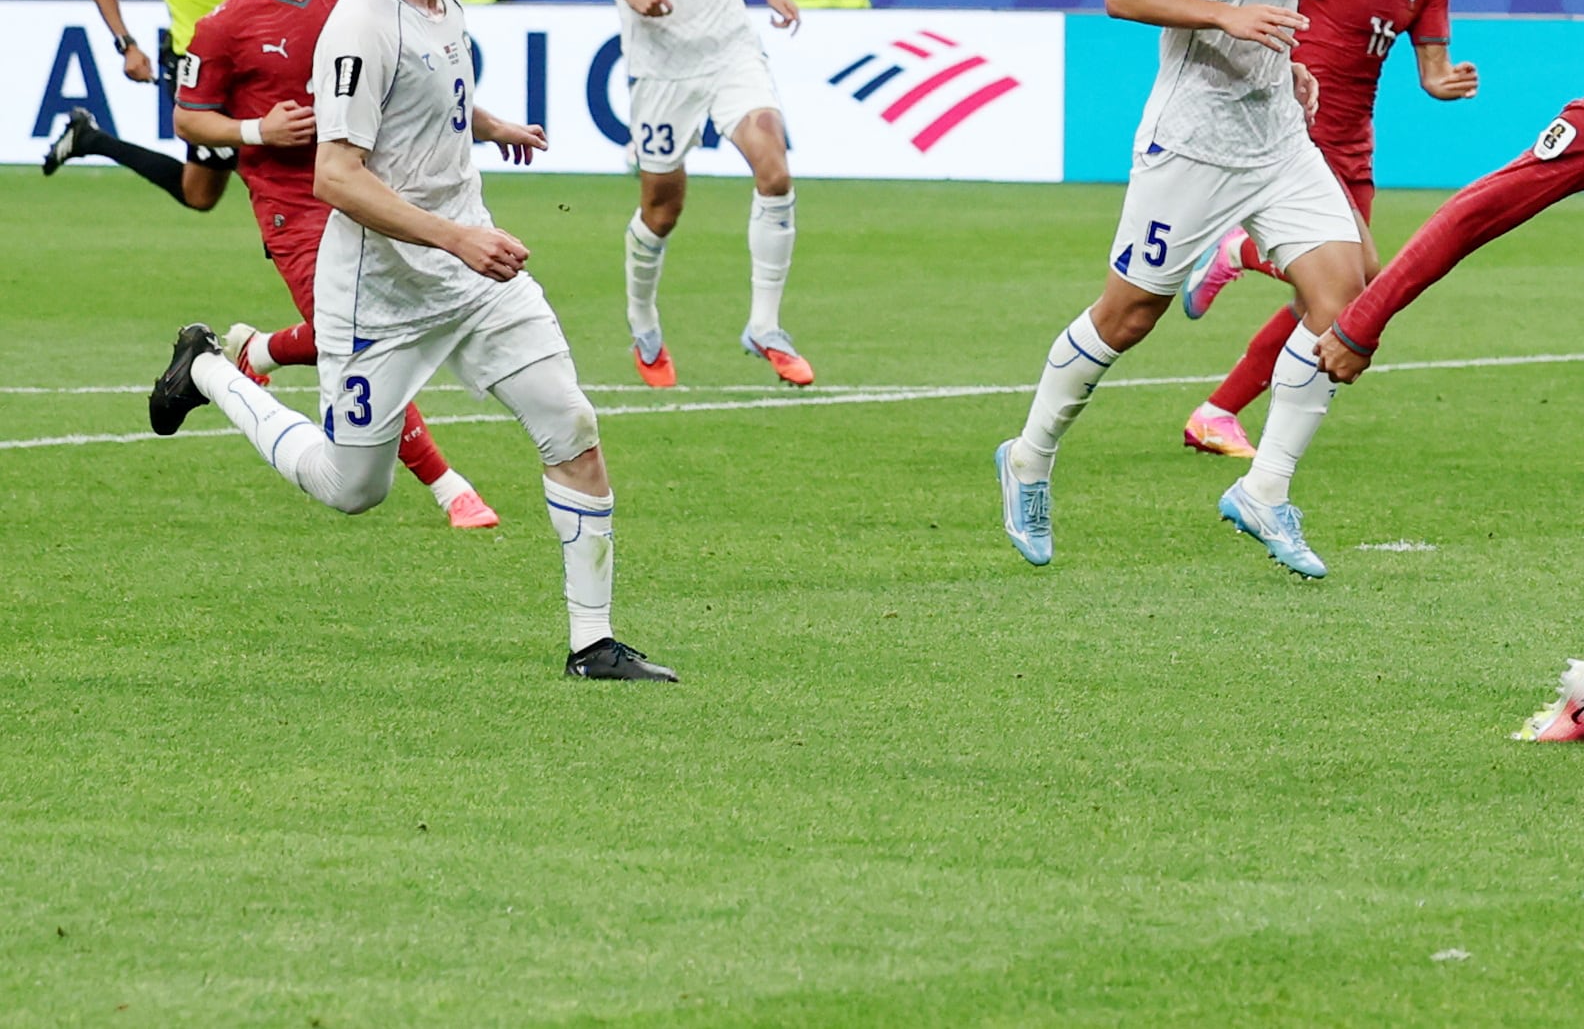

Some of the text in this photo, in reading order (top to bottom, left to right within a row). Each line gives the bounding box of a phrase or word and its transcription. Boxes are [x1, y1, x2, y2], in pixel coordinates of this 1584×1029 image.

[452, 77, 467, 133] 3
[641, 122, 674, 155] 23
[1142, 220, 1171, 268] 5
[344, 375, 372, 428] 3
